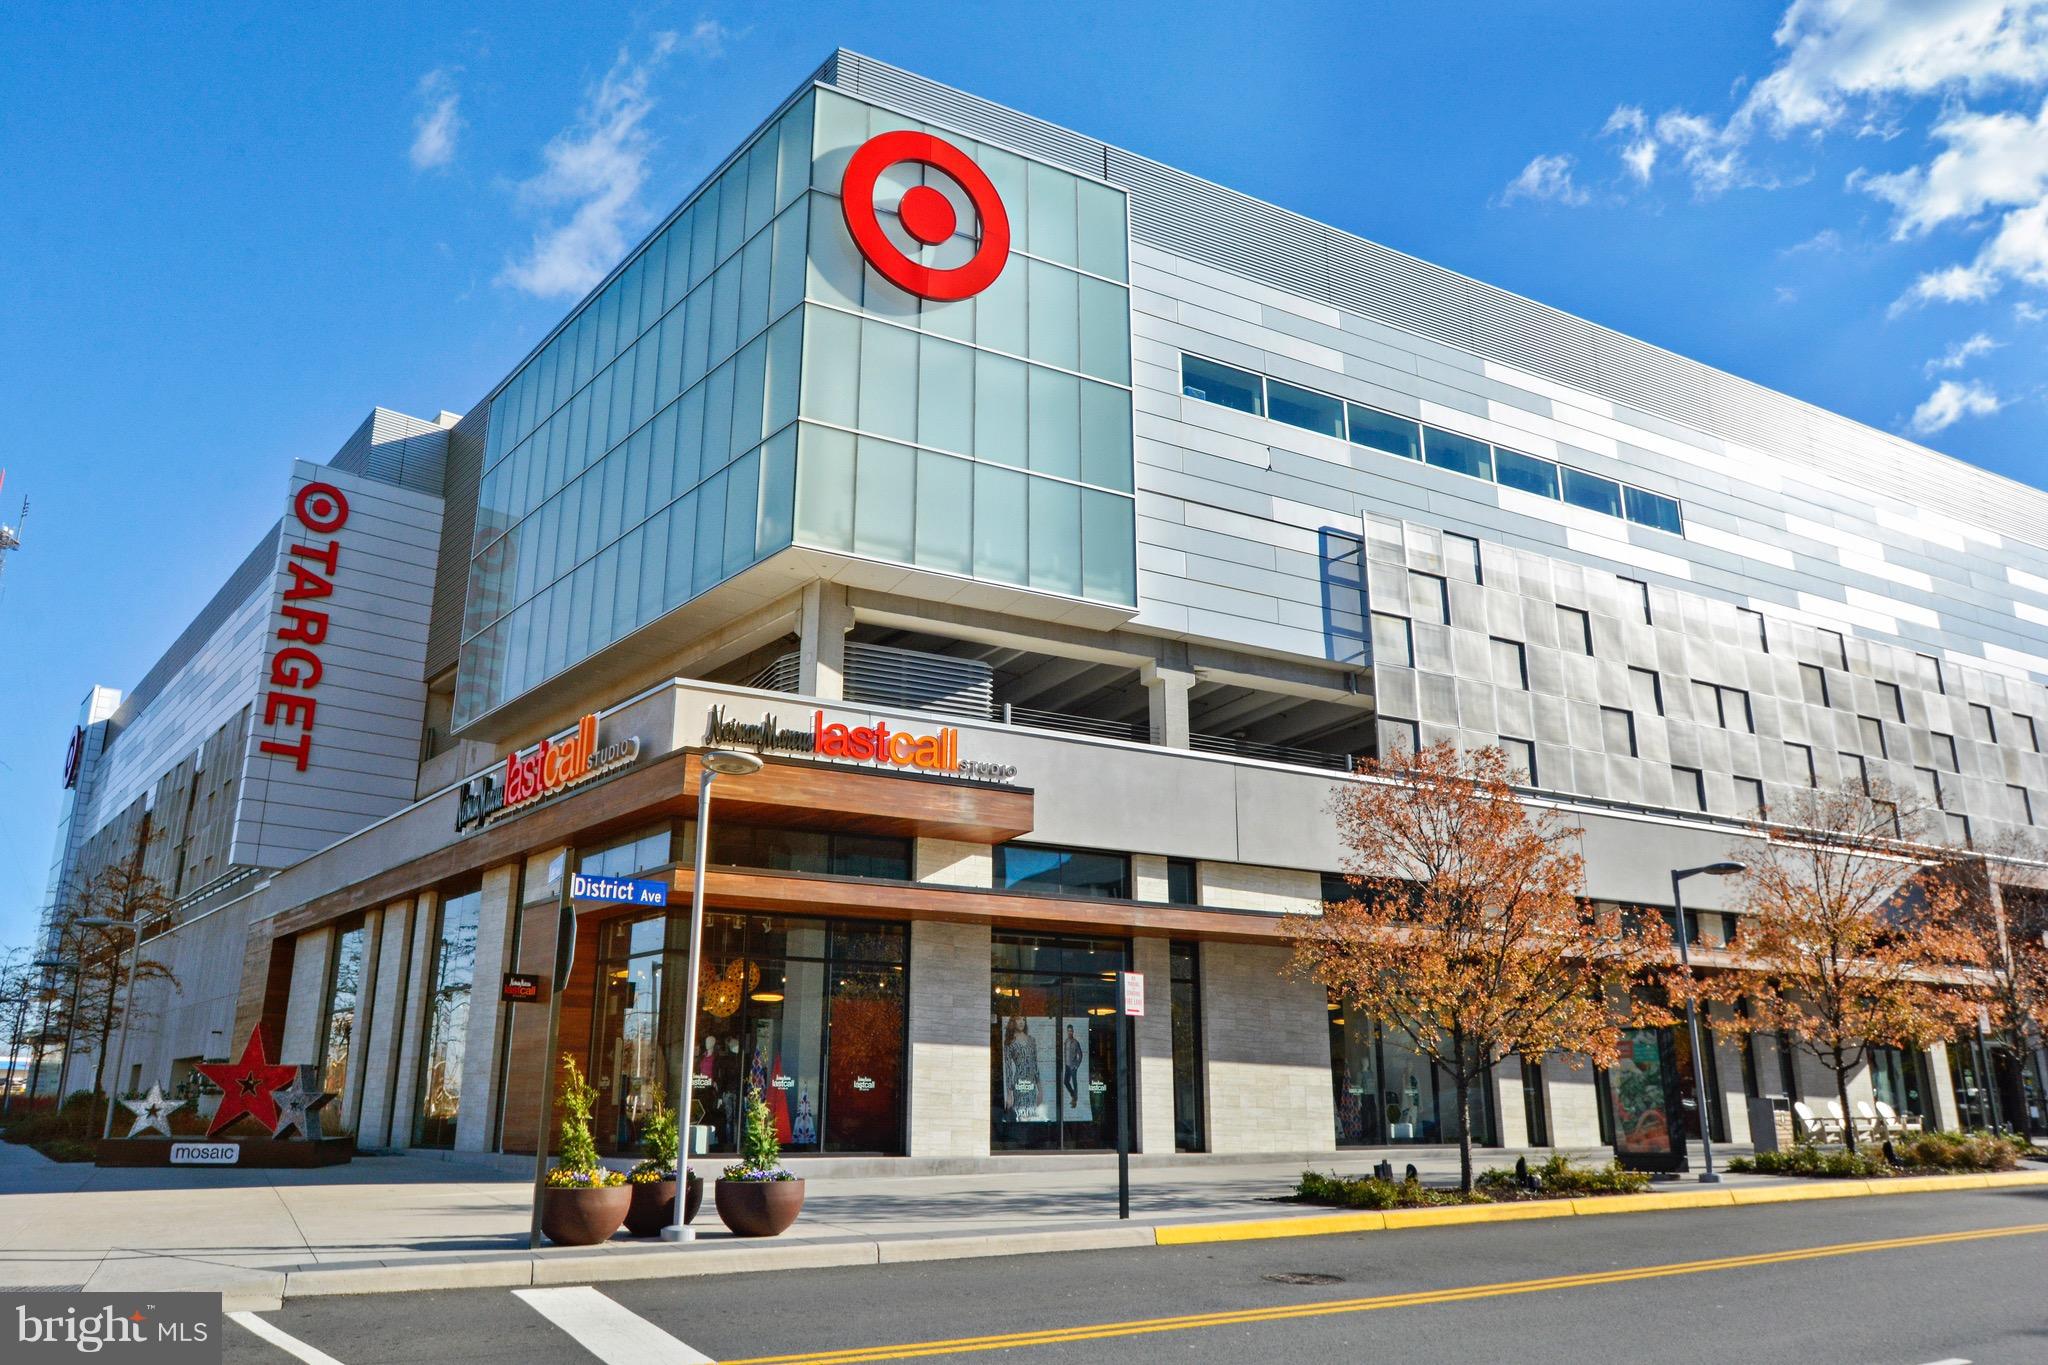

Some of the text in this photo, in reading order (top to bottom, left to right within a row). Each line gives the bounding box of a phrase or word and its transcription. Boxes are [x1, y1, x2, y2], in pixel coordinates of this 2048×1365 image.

[259, 541, 340, 772] TARGET
[586, 739, 631, 770] STUDIO
[959, 759, 1018, 779] STUDIO
[574, 876, 662, 903] District Ave
[175, 1147, 234, 1160] mosaic
